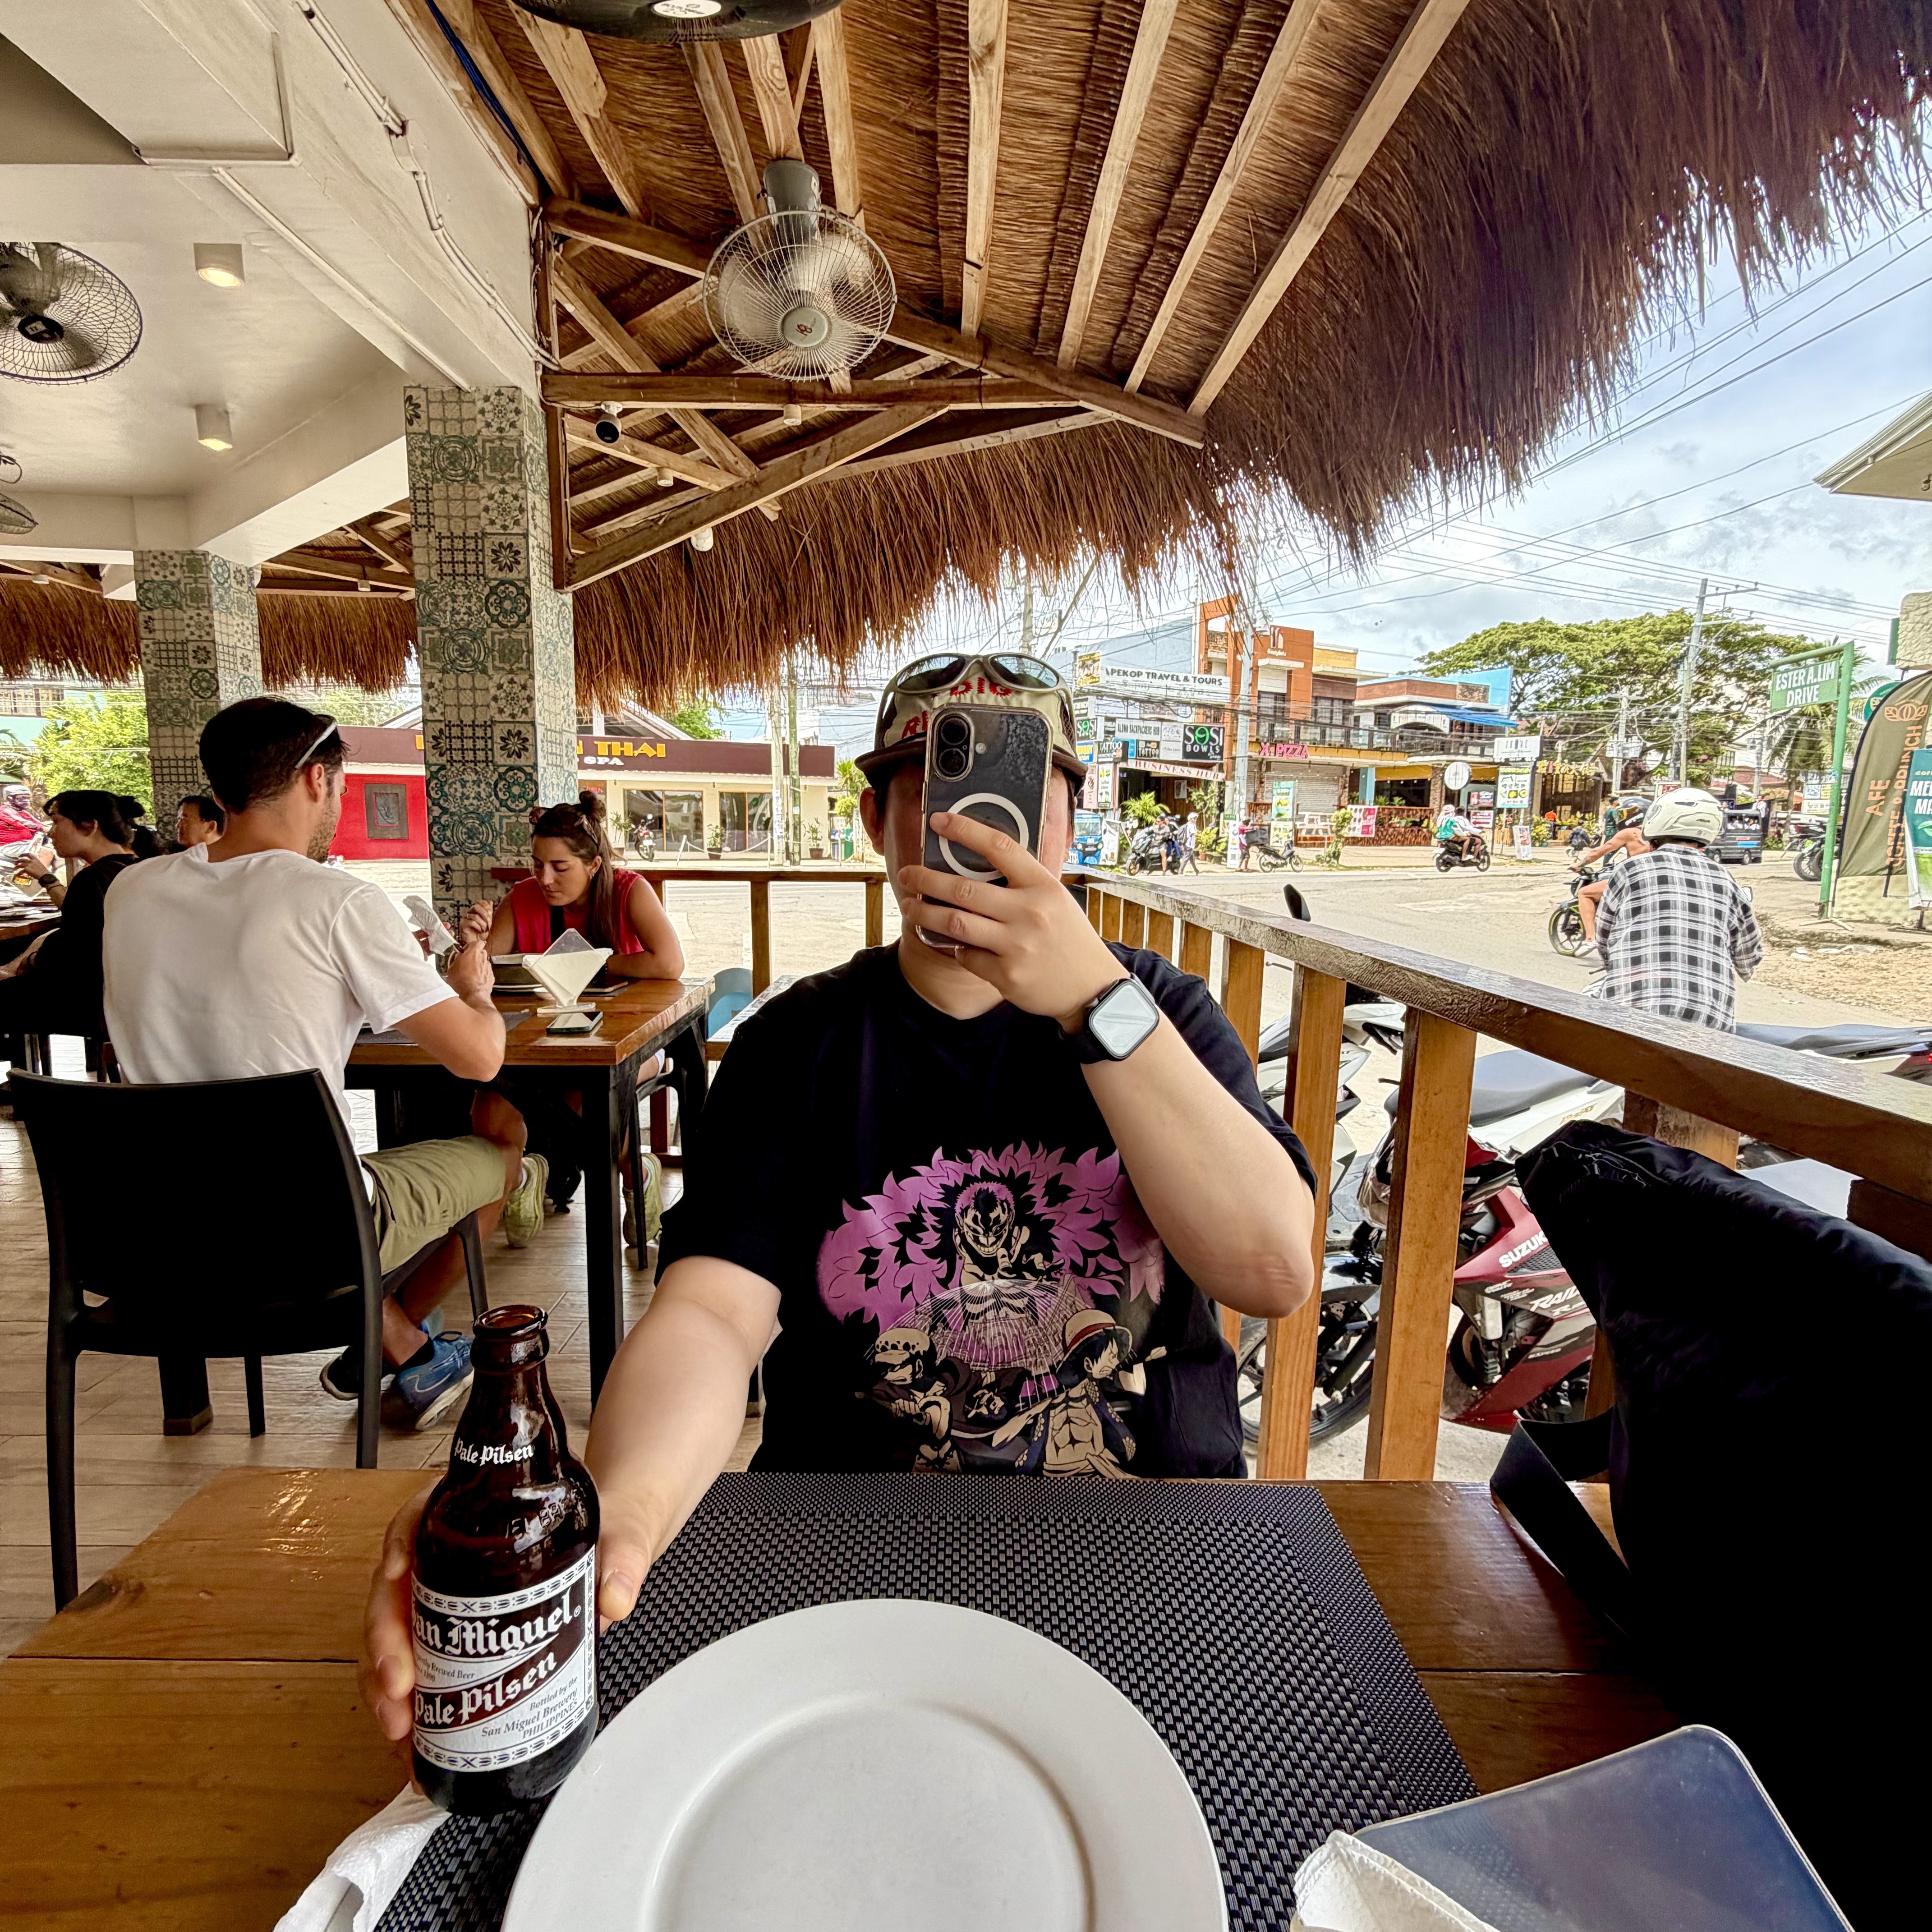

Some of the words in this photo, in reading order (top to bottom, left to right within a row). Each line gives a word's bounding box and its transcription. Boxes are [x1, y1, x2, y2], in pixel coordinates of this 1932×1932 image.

[1145, 672, 1181, 682] TRAVEL
[1191, 676, 1223, 686] TOURS
[1776, 668, 1806, 692] ESTER
[1806, 661, 1838, 685] A.LIM
[1786, 684, 1820, 708] DRIVE
[1184, 726, 1223, 746] SOSI
[594, 741, 666, 758] THAI
[1099, 741, 1122, 753] TATTOO
[1138, 747, 1159, 757] TATTOO
[1186, 745, 1220, 753] BOWLS
[584, 756, 624, 765] SPA
[1135, 760, 1192, 775] BUSINESS
[1909, 781, 1932, 796] ME
[454, 1437, 479, 1464] Pale
[479, 1444, 534, 1466] Pilsen
[431, 1663, 455, 1677] Brewed
[457, 1670, 475, 1679] Beer
[414, 1689, 455, 1725] Pale
[458, 1652, 557, 1725] Pilsen
[529, 1690, 557, 1711] Bottled
[559, 1685, 567, 1697] by
[481, 1726, 501, 1737] San
[503, 1711, 540, 1732] Miguel
[542, 1688, 578, 1719] Brewery
[522, 1697, 578, 1739] PHILIPPINES
